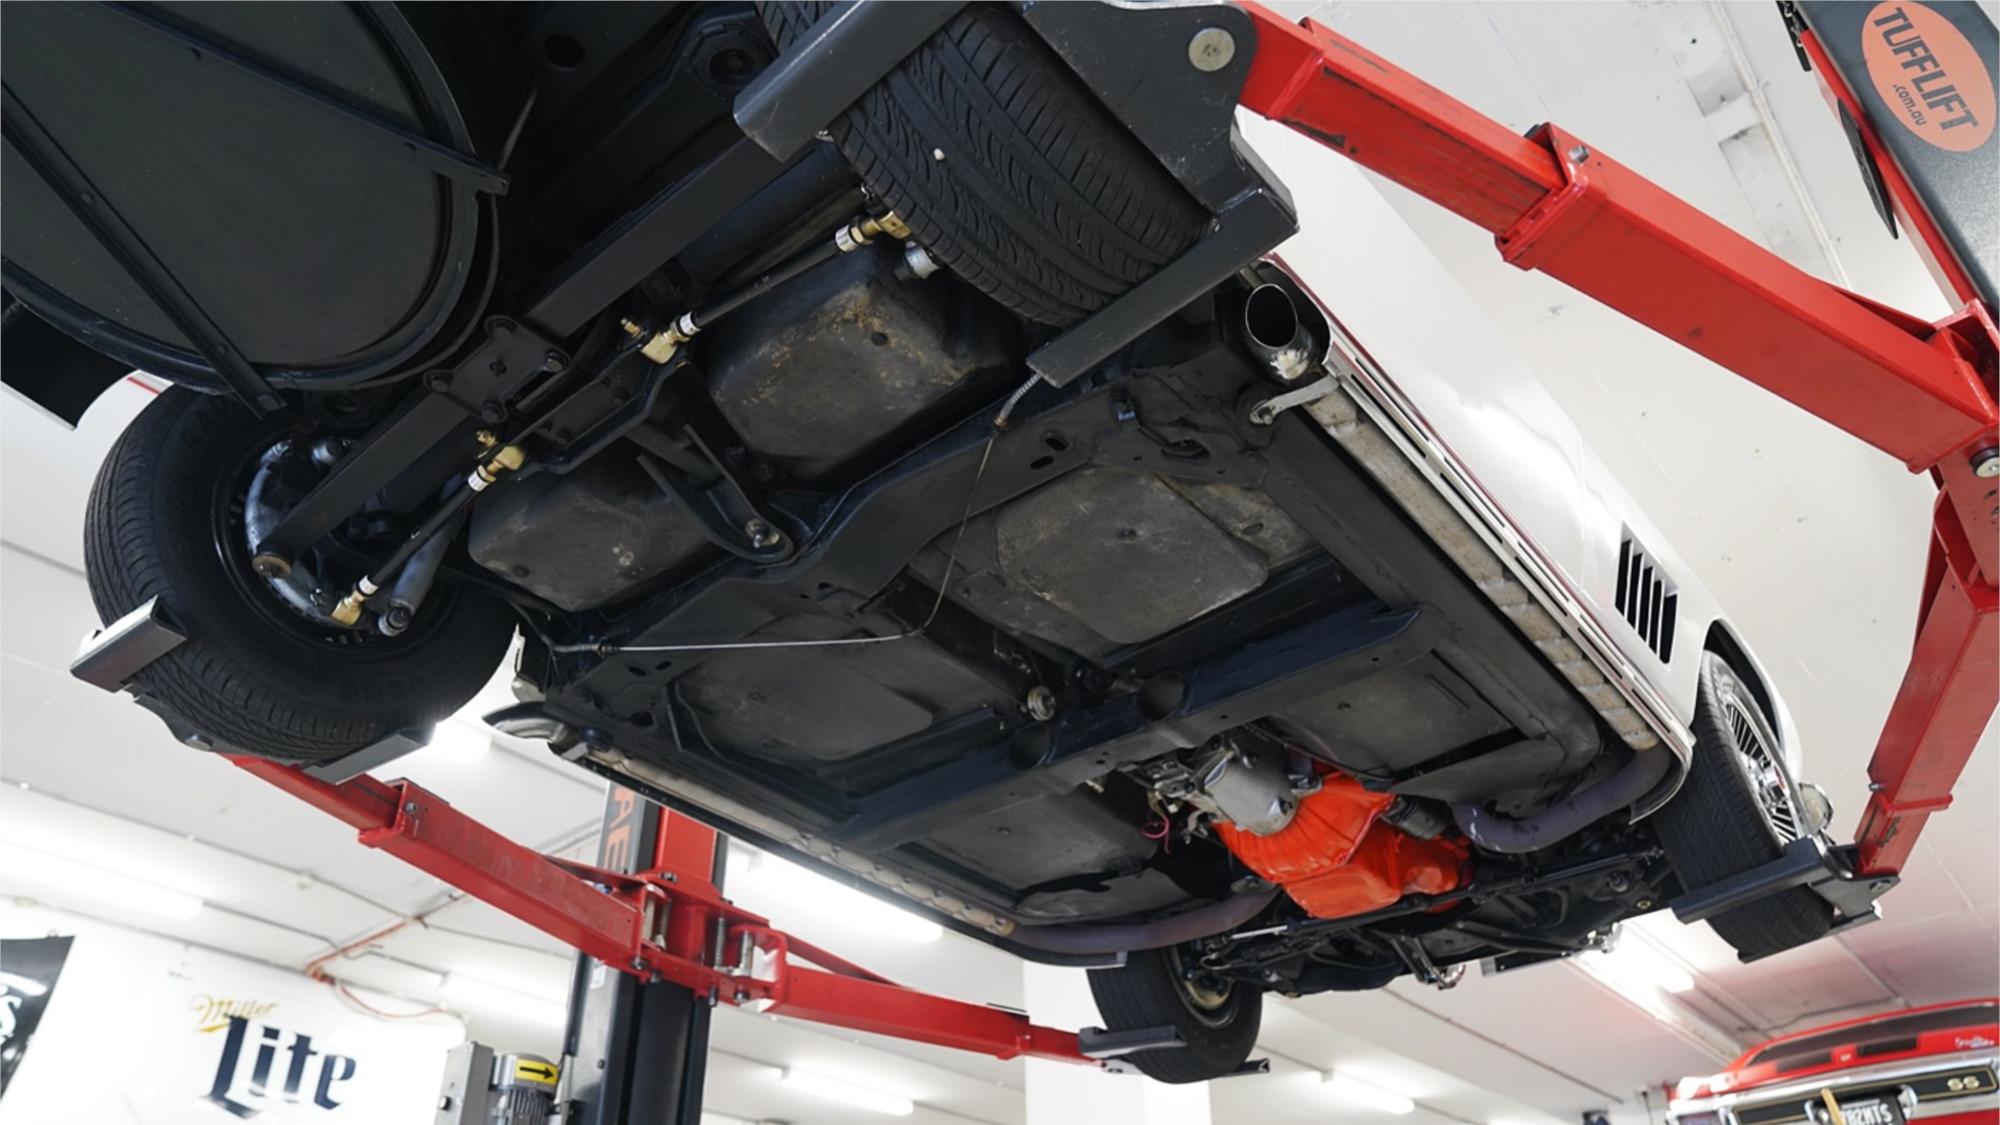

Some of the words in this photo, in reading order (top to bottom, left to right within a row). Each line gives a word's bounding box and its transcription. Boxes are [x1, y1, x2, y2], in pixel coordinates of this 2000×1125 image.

[1874, 7, 1979, 130] TUFFLIFT
[1892, 84, 1927, 126] .com.au
[191, 994, 278, 1025] Miller
[199, 1013, 357, 1120] Lite
[1947, 1075, 1980, 1092] SS
